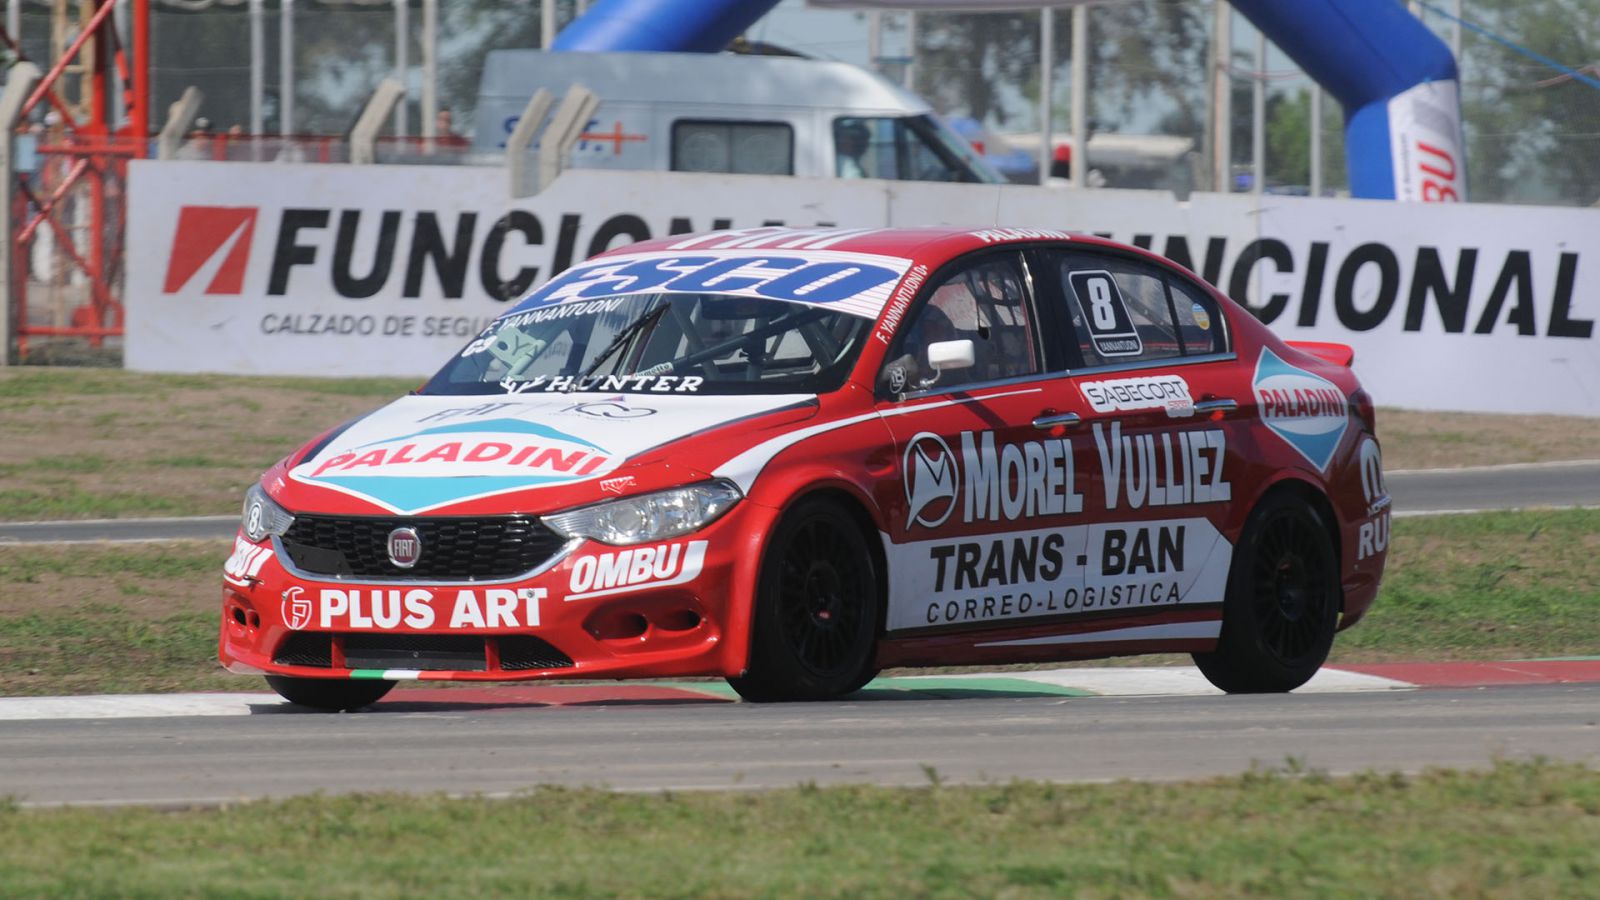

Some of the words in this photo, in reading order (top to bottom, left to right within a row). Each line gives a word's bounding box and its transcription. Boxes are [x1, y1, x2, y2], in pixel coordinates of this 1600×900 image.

[1417, 141, 1458, 202] BU
[266, 207, 837, 302] FUNCI
[880, 271, 922, 336] YANNANTUONI
[1087, 278, 1117, 330] 8
[1092, 232, 1596, 338] NCIONAL
[260, 313, 376, 336] CALZADO
[382, 315, 415, 337] DE
[423, 316, 498, 337] SEGU
[497, 298, 625, 331] YANNANTUONI
[545, 374, 704, 392] HUNTER
[1087, 380, 1187, 406] SABECORT
[1259, 388, 1345, 418] PALADINI
[309, 441, 610, 478] PALADINI
[960, 430, 1084, 523] MOREL
[1092, 421, 1232, 510] VULLIEZ
[250, 506, 260, 532] 8
[394, 539, 414, 557] FIAT
[570, 543, 681, 592] OMBU
[930, 533, 1065, 592] TRANS
[1102, 525, 1185, 576] BAN
[320, 588, 436, 629] PLUS
[449, 588, 549, 628] ART
[927, 581, 1181, 623] CORREO-LOGISTICA
